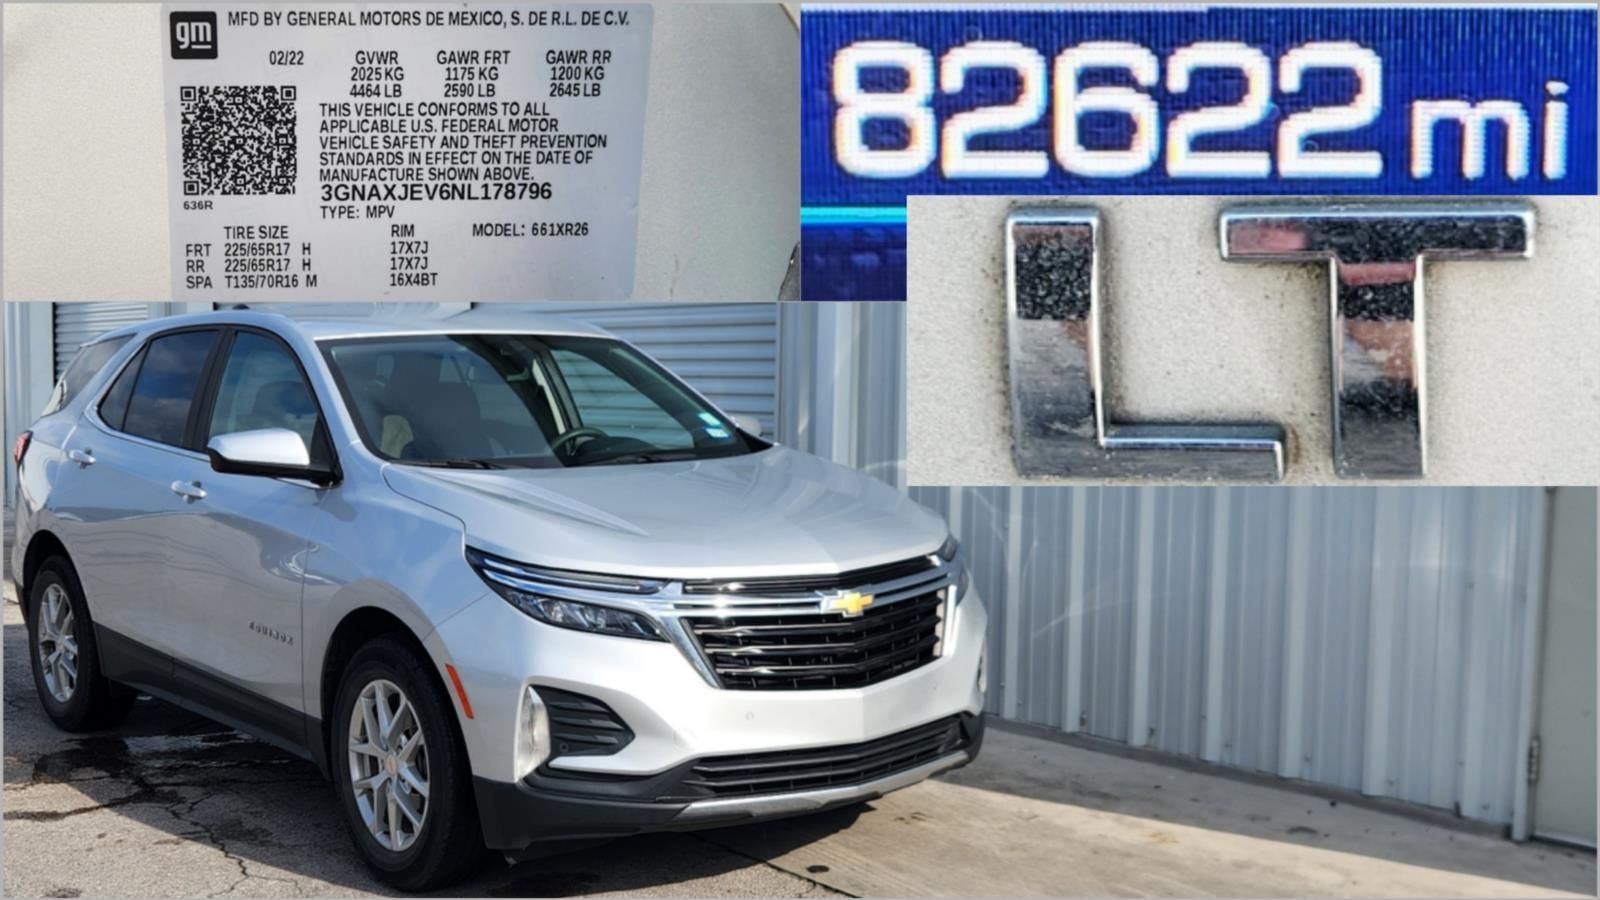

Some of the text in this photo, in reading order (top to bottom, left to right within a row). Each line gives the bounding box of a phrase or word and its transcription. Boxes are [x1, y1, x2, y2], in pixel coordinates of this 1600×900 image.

[228, 11, 628, 27] MFD BY GENERAL MOTORS DE MEXICO, S. DE R.L. DE C.V.
[176, 22, 212, 49] gm
[269, 51, 304, 65] 02/22
[356, 50, 398, 65] GVWR
[437, 50, 510, 64] GAWR FRT
[546, 50, 611, 64] GAWR RR
[351, 67, 404, 81] 2025 KG
[446, 66, 498, 81] 1175 KG
[551, 66, 604, 80] 1200 KG
[350, 84, 402, 97] 4464 LB
[444, 83, 495, 97] 2590 LB
[550, 83, 600, 97] 2645 LB
[320, 102, 549, 116] THIS VEHICLE CONFORMS TO ALL
[834, 40, 1568, 180] 82622 mi
[320, 118, 558, 133] APPLICABLE U.S. FEDERAL MOTOR
[320, 134, 607, 149] VEHICLE SAFETY AND THEFT PREVENTION
[320, 150, 592, 166] STANDARDS IN EFFECT ON THE DATE OF
[320, 167, 535, 181] MANUFACTURE SHOWN ABOVE.
[322, 182, 552, 201] 3GNAXJEV6NL178796
[184, 201, 213, 210] 636R
[320, 205, 395, 219] TYPE: MPV
[224, 225, 288, 239] TIRE SIZE
[392, 224, 414, 237] RIM
[473, 222, 588, 236] MODEL: 661XR26
[186, 243, 310, 256] FRT 225/65R17 H
[391, 241, 428, 254] 17X7J
[187, 258, 310, 272] RR 225/65R17 H
[391, 257, 428, 270] 17X7J
[187, 274, 317, 289] SPA T135/70R16 M
[391, 273, 437, 286] 16X4BT
[1005, 204, 1536, 480] LT
